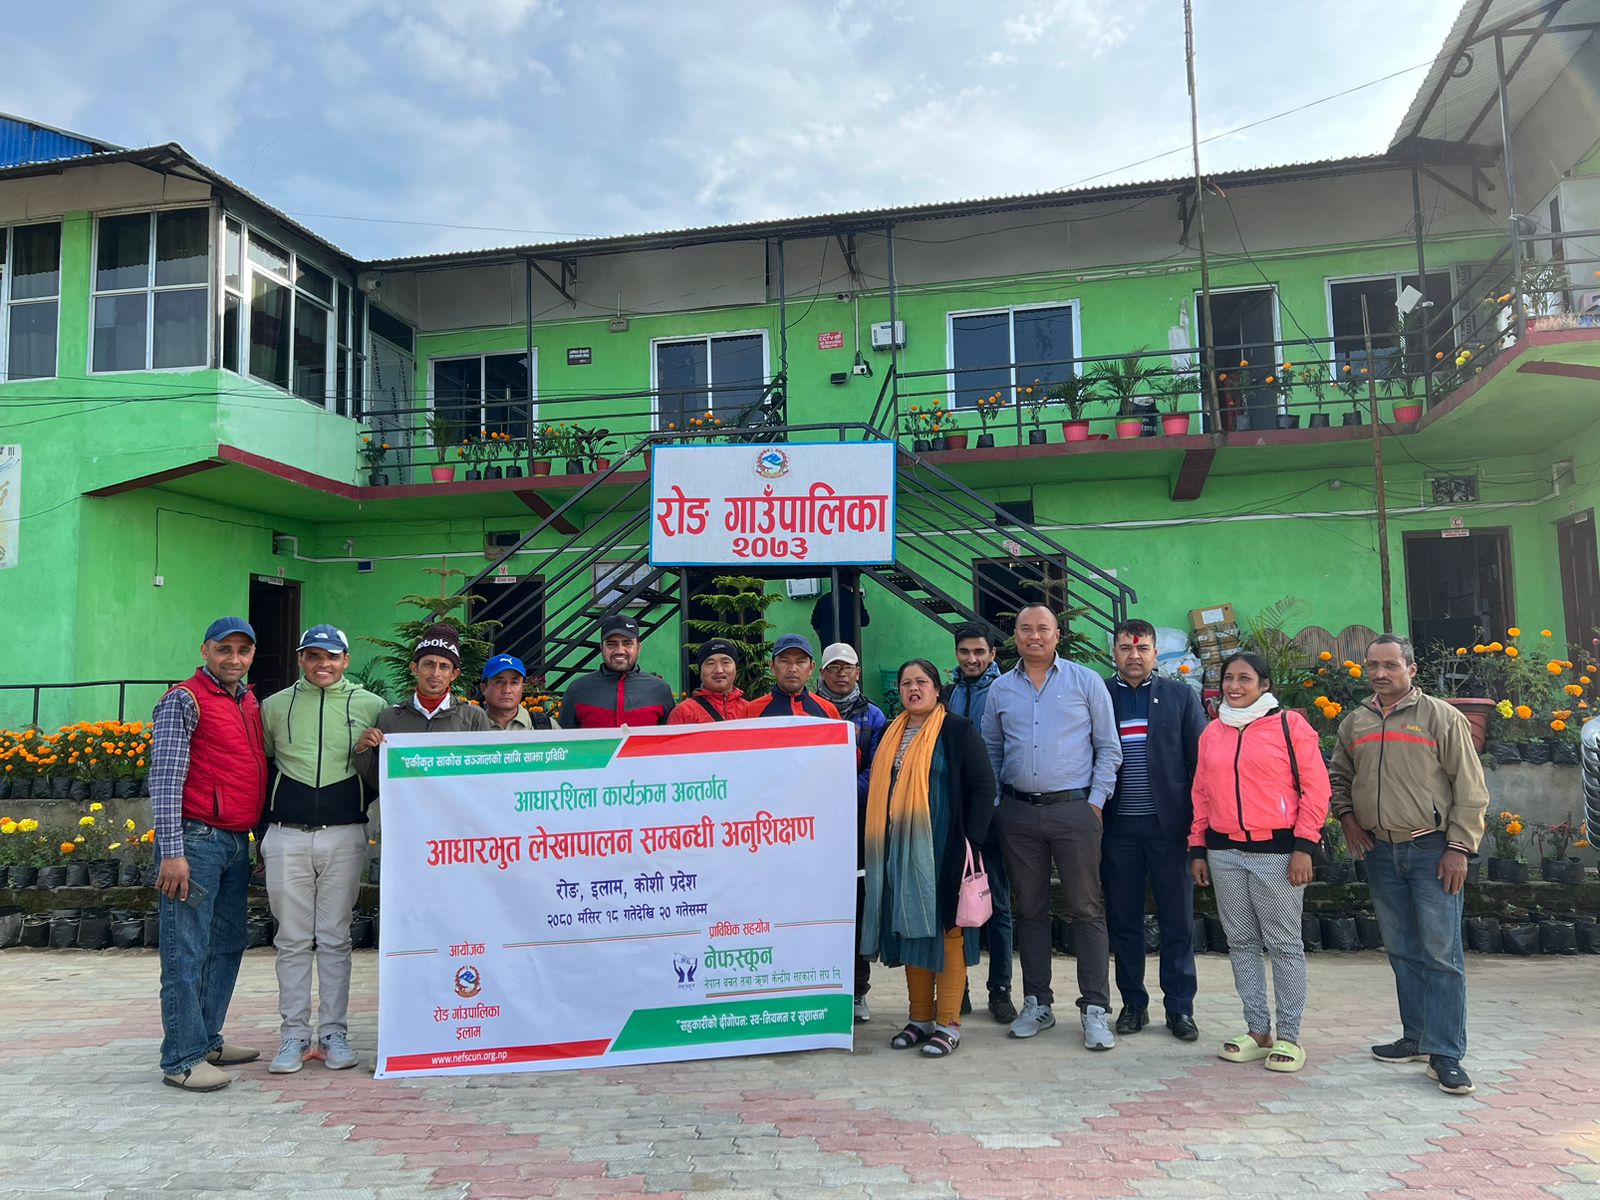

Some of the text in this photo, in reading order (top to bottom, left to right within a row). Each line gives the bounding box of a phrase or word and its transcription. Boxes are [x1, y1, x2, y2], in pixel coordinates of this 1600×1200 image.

[657, 481, 889, 537] रोङ गाउँपालिका
[732, 536, 809, 560] २०७३
[436, 752, 462, 767] साकोस
[503, 750, 521, 764] लागि
[514, 774, 728, 813] आधारशिला कार्यक्रम अन्तर्गत
[426, 810, 815, 870] आधारभुत लेखापालन सम्बन्धी अनुशिक्षण
[556, 870, 697, 902] रोङ, इलाम, कोशी प्रदेश
[547, 913, 573, 928] २०८०
[606, 910, 619, 924] १८
[623, 903, 655, 922] गतेदेखि
[659, 906, 671, 921] २०
[675, 901, 708, 918] गतेसम्म
[709, 918, 770, 940] प्राविधिक सहयोग
[449, 941, 486, 957] आयोजक
[704, 977, 720, 989] नेपाल
[793, 967, 817, 984] सहकारी
[433, 1006, 450, 1022] रोङ
[790, 1010, 796, 1022] र
[456, 1025, 481, 1041] इलाम
[431, 1050, 508, 1065] www.nefscun.org.np
